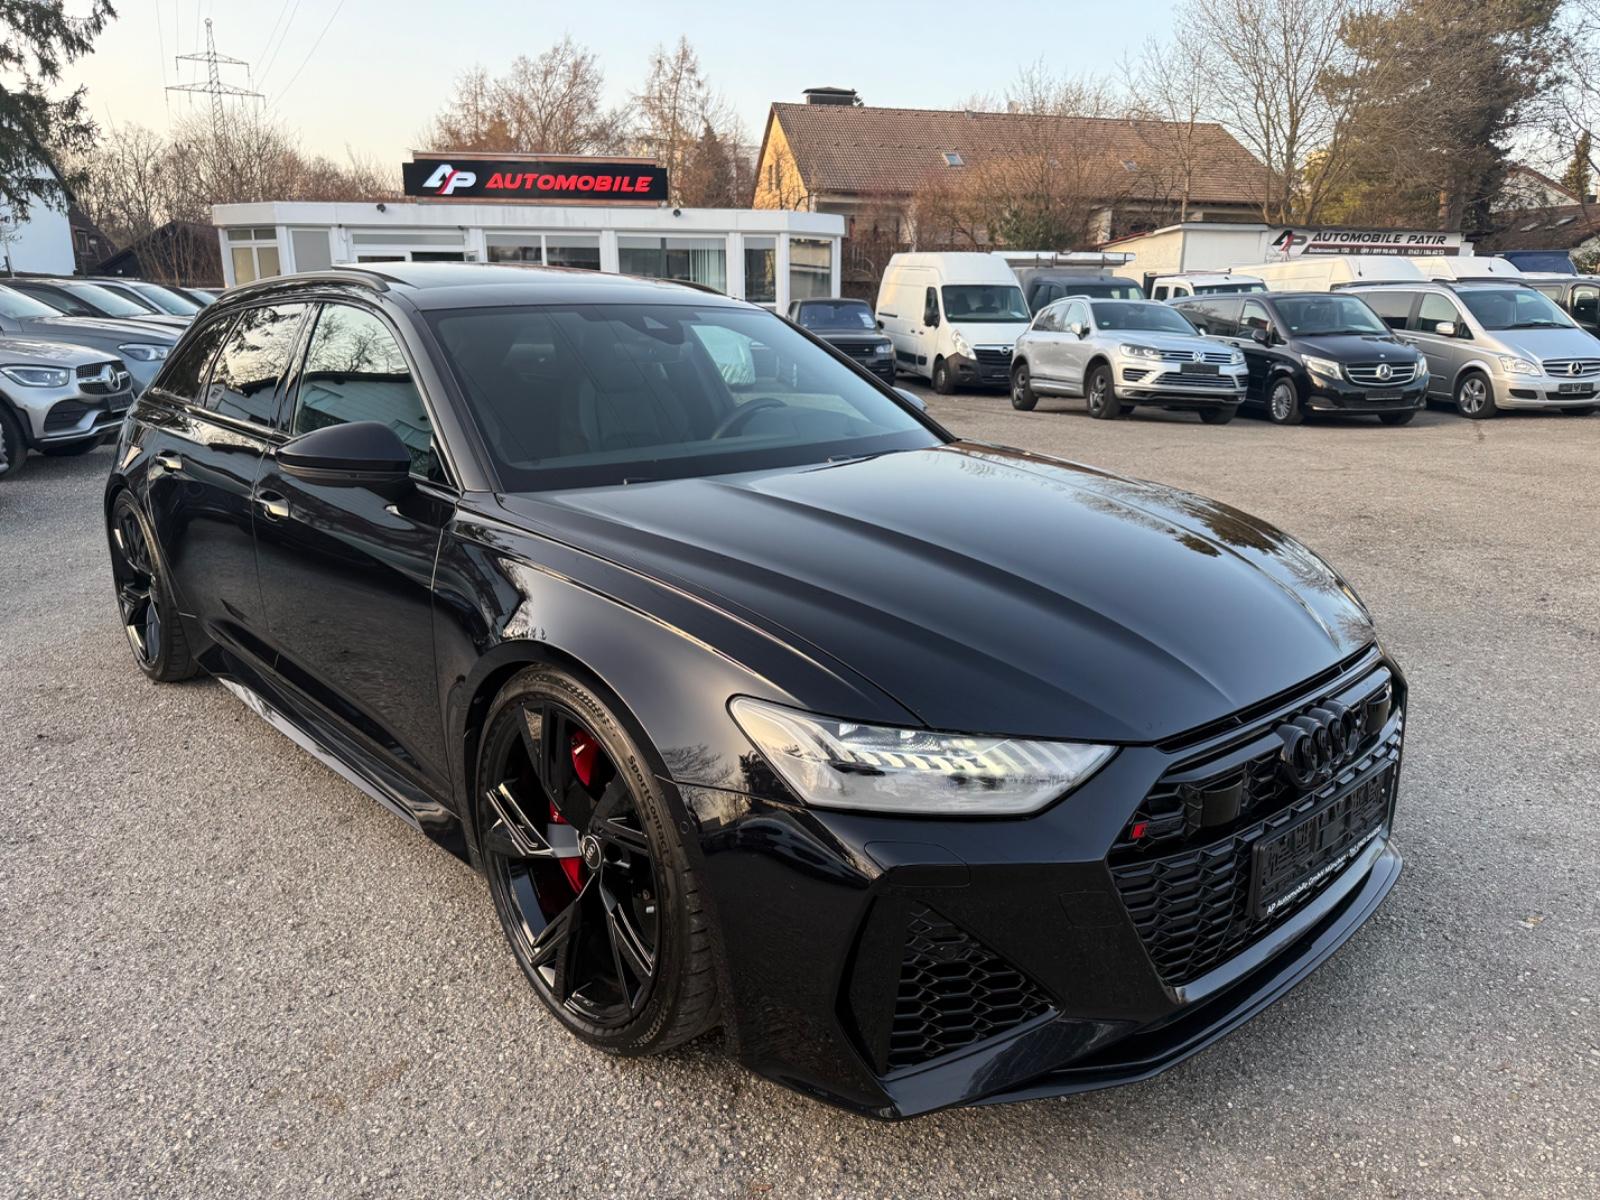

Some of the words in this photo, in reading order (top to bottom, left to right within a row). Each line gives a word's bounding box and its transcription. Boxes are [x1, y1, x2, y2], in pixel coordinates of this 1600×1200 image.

[485, 173, 653, 192] AUTOMOBILE
[1311, 232, 1403, 244] AUTOMOBILE
[1406, 234, 1447, 245] PATIR
[628, 755, 669, 855] SportContact
